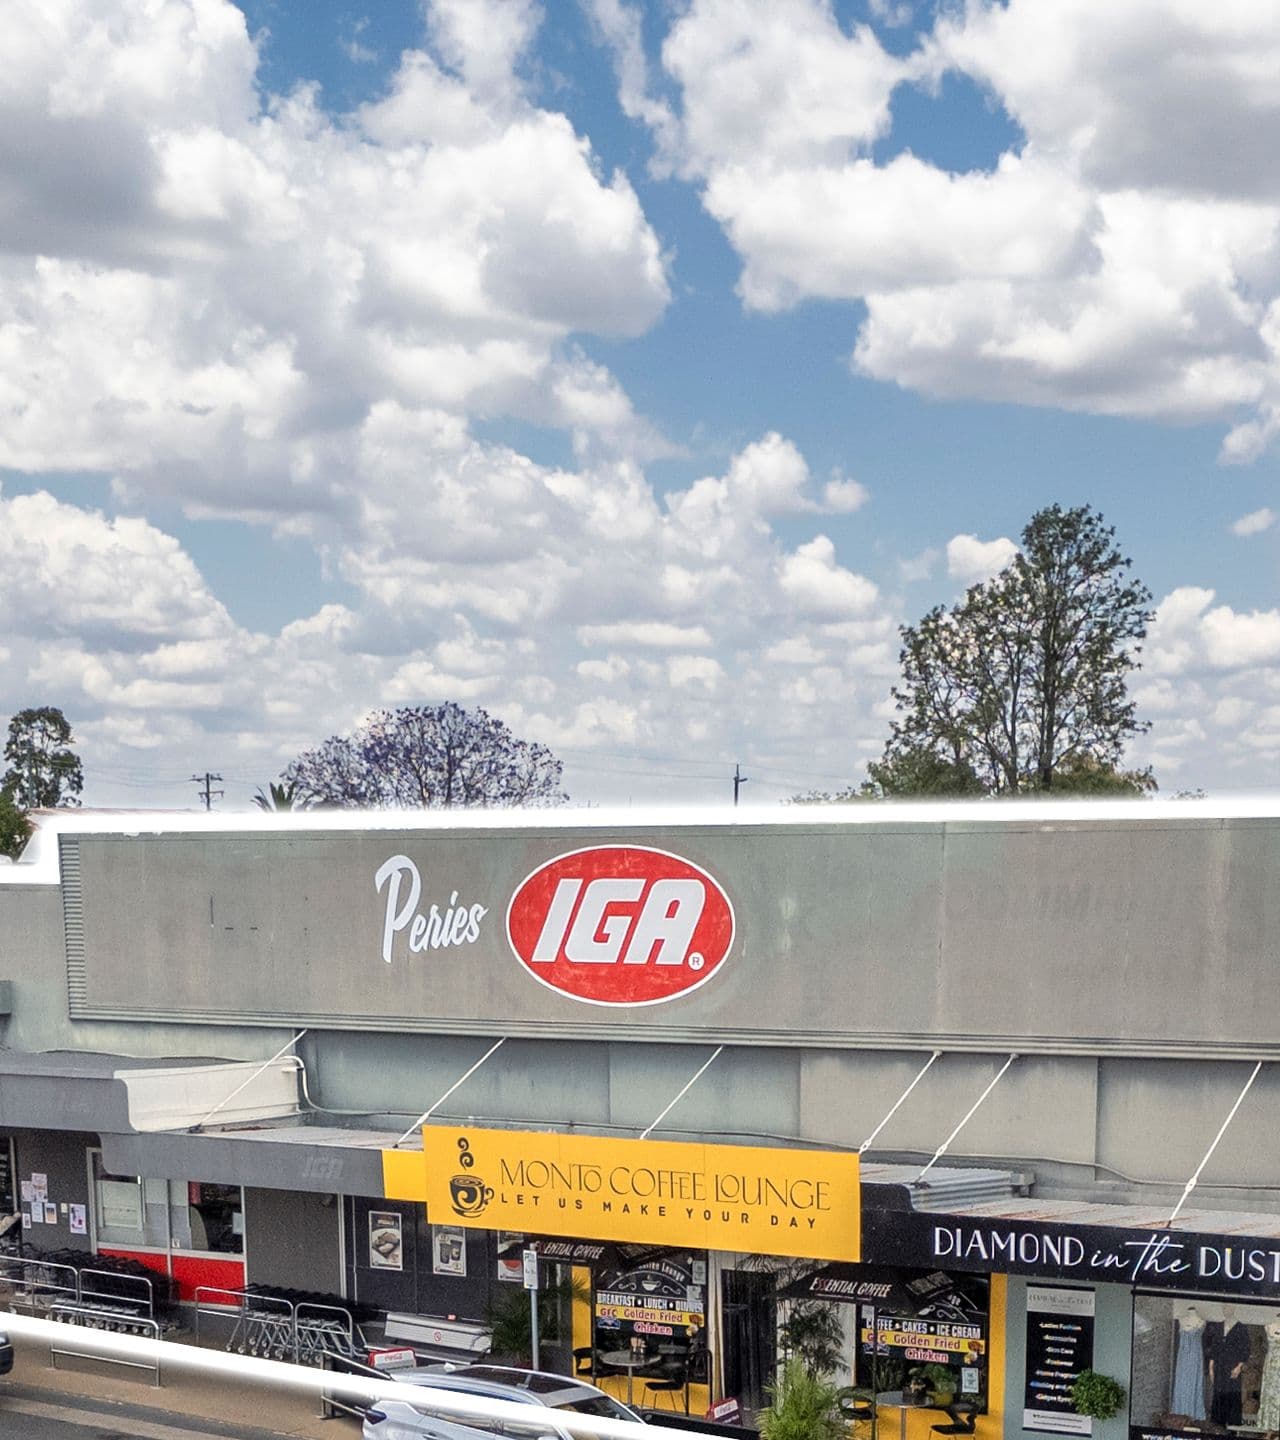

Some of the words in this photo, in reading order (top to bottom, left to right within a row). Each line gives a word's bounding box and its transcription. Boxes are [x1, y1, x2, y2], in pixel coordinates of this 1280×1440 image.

[374, 854, 488, 964] Peries
[531, 877, 706, 966] IGA
[500, 1158, 602, 1193] MONTO
[609, 1166, 706, 1202] COFFEE
[714, 1174, 831, 1211] LOUNGE
[501, 1195, 540, 1206] LET
[558, 1198, 584, 1210] US
[603, 1201, 666, 1217] MAKE
[685, 1207, 750, 1224] YOUR
[770, 1215, 817, 1230] DAY
[573, 1244, 605, 1259] COFFEE
[933, 1227, 1084, 1266] DIAMOND
[1090, 1250, 1129, 1268] in
[809, 1276, 857, 1295] ESSENTIAL
[856, 1281, 893, 1298] COFFEE
[596, 1293, 636, 1307] BREAKFAST
[643, 1297, 668, 1310] LUNCH
[600, 1307, 618, 1317] GFC
[623, 1308, 656, 1320] Golden
[660, 1312, 683, 1322] Fried
[633, 1321, 674, 1336] Chicken
[901, 1320, 927, 1334] CAKES
[936, 1324, 950, 1337] ICE
[951, 1326, 982, 1340] CREAM
[867, 1333, 887, 1344] GC
[893, 1333, 930, 1348] Golden
[934, 1338, 961, 1350] Fried
[904, 1347, 950, 1363] Chicken
